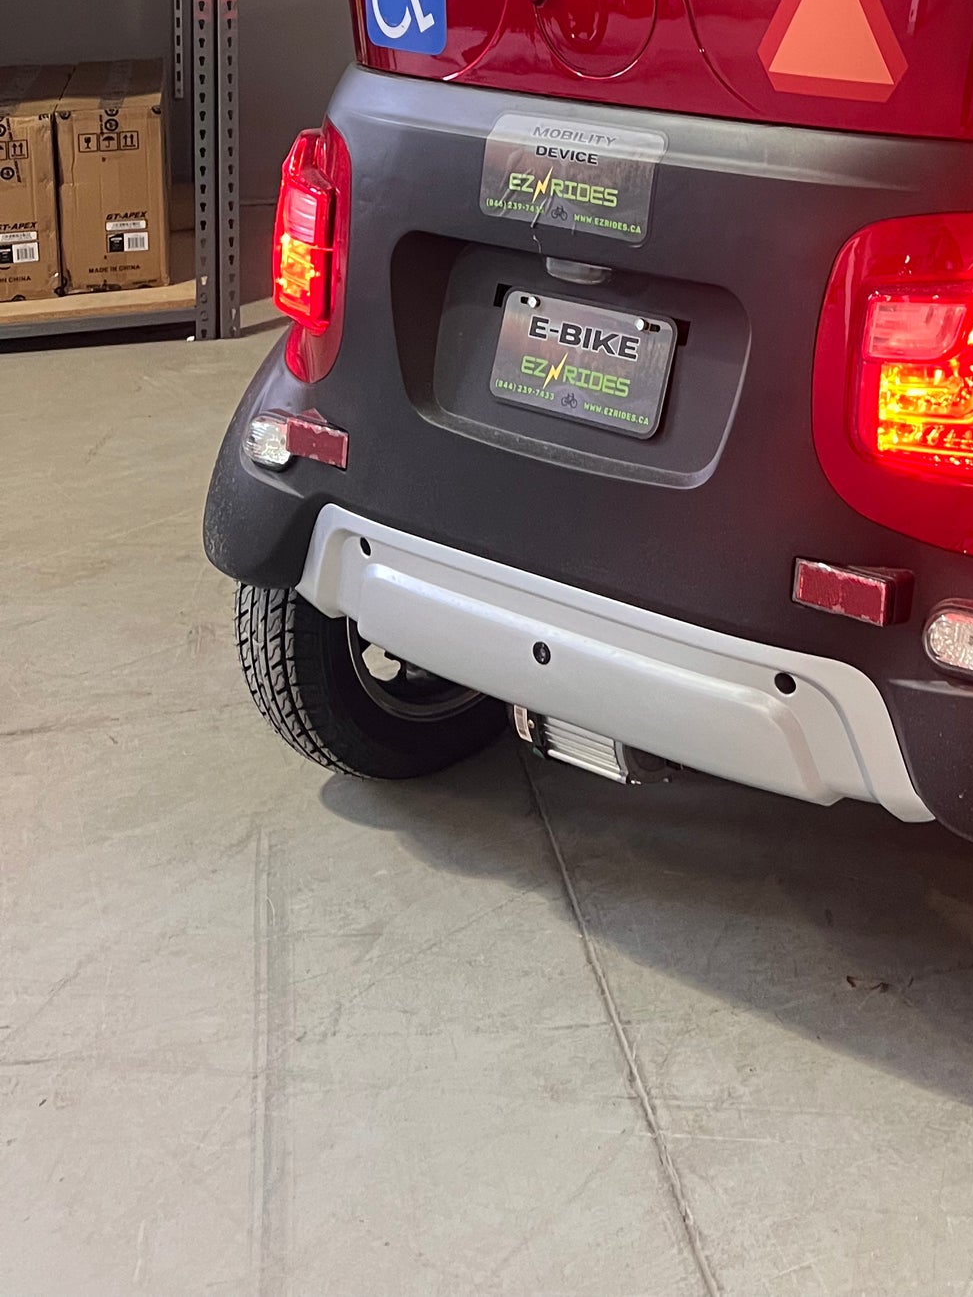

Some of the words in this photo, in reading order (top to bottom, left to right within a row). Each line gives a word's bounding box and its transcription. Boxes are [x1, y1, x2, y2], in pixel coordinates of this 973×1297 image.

[532, 126, 617, 147] MOBILITY
[536, 145, 599, 165] DEVICE
[106, 211, 147, 220] GT-APEX
[0, 222, 37, 231] T-APEX
[119, 264, 140, 272] CHINA
[8, 275, 32, 283] CHINA
[529, 316, 640, 360] E-BIKE
